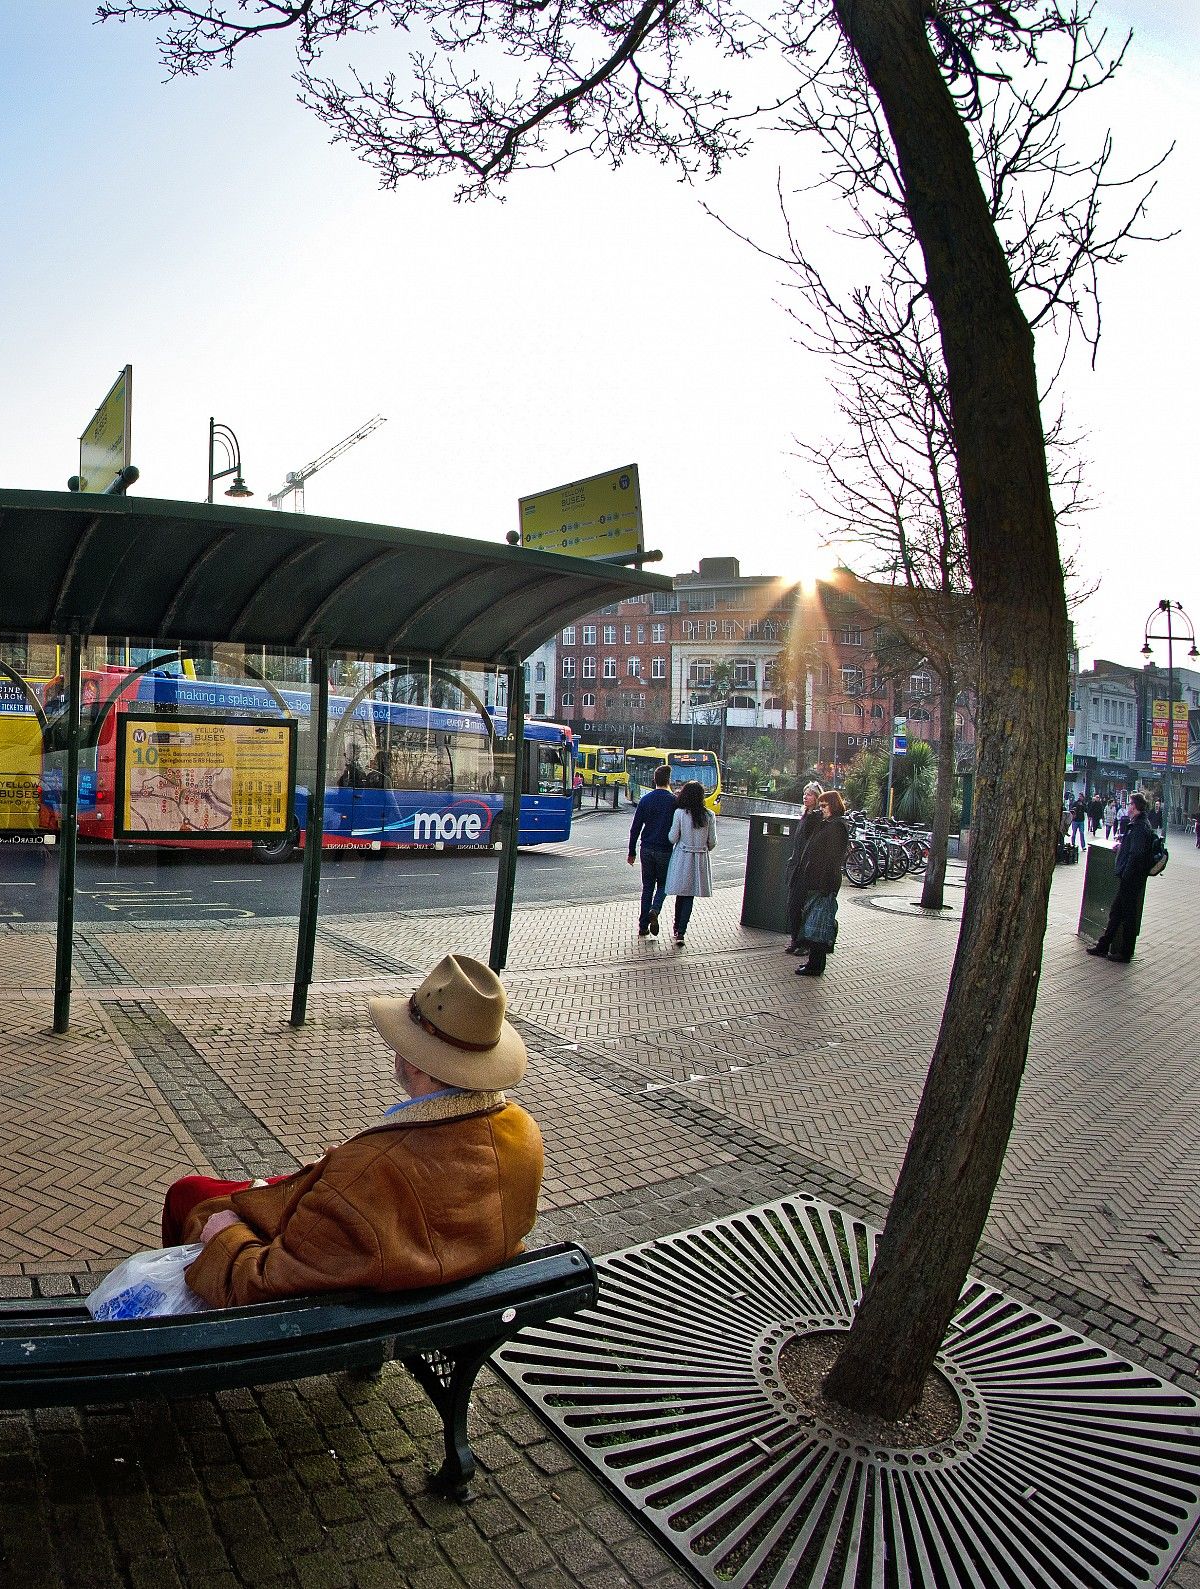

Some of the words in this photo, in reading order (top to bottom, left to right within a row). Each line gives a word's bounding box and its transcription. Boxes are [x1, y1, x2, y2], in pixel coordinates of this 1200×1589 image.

[560, 487, 585, 498] YELLOW
[561, 495, 586, 507] BUSES
[682, 619, 791, 633] DEBENHAM
[1, 703, 24, 711] TICKETS
[175, 689, 216, 704] making
[227, 694, 261, 707] splash
[368, 708, 391, 719] Poole
[446, 718, 464, 730] every
[464, 718, 470, 729] 3
[194, 734, 226, 742] BUSES
[132, 747, 159, 765] 10
[0, 781, 40, 789] YELLOW
[0, 790, 40, 798] BUSES
[413, 812, 482, 840] more
